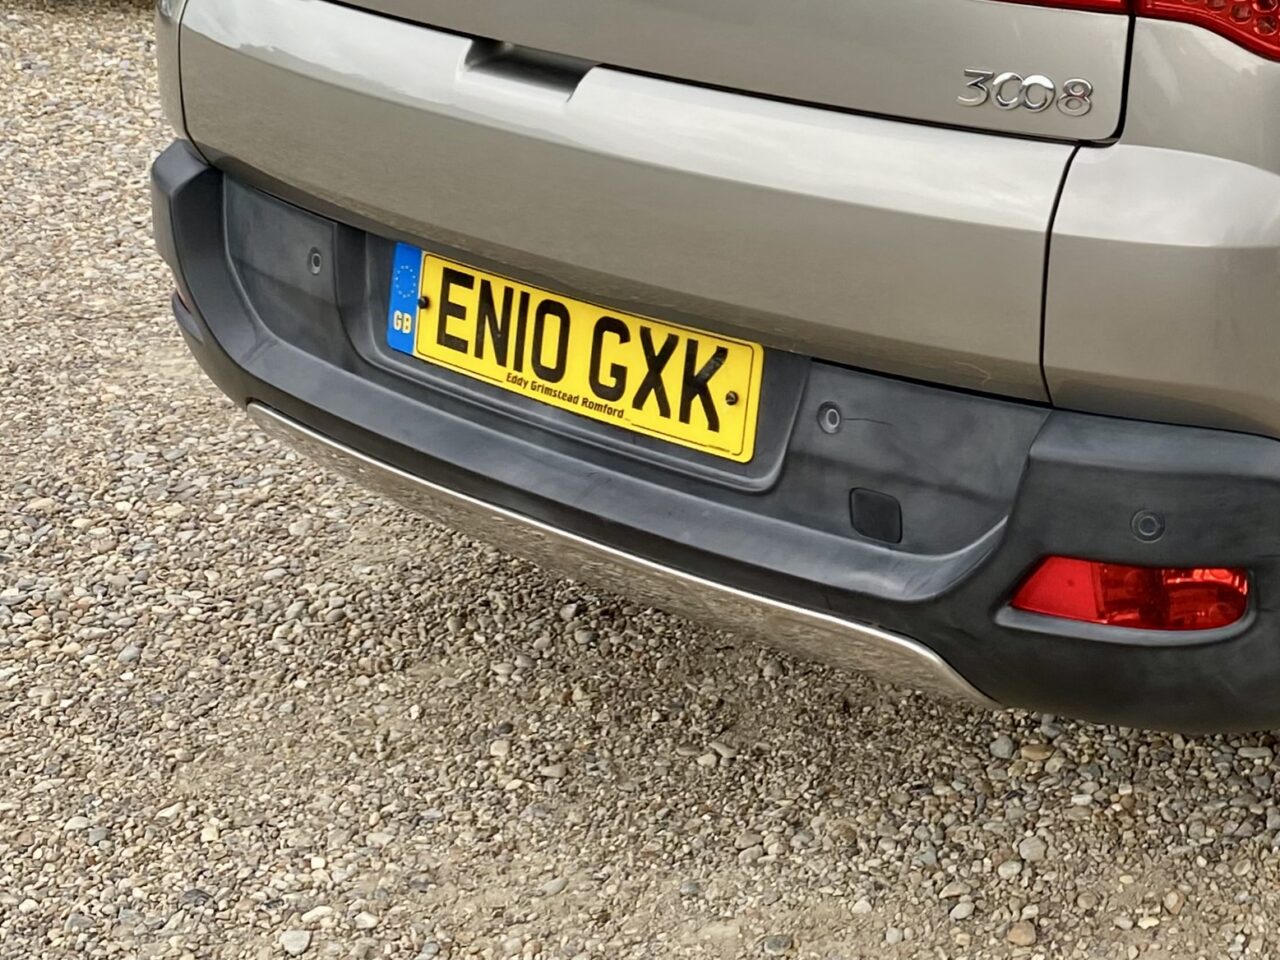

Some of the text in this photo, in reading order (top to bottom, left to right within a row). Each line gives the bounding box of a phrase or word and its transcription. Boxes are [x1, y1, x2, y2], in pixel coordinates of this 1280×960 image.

[956, 67, 1095, 117] 3008
[393, 310, 413, 334] GB
[436, 267, 730, 433] EN10 GXK
[506, 372, 625, 420] Eddy Grimstead Romford
